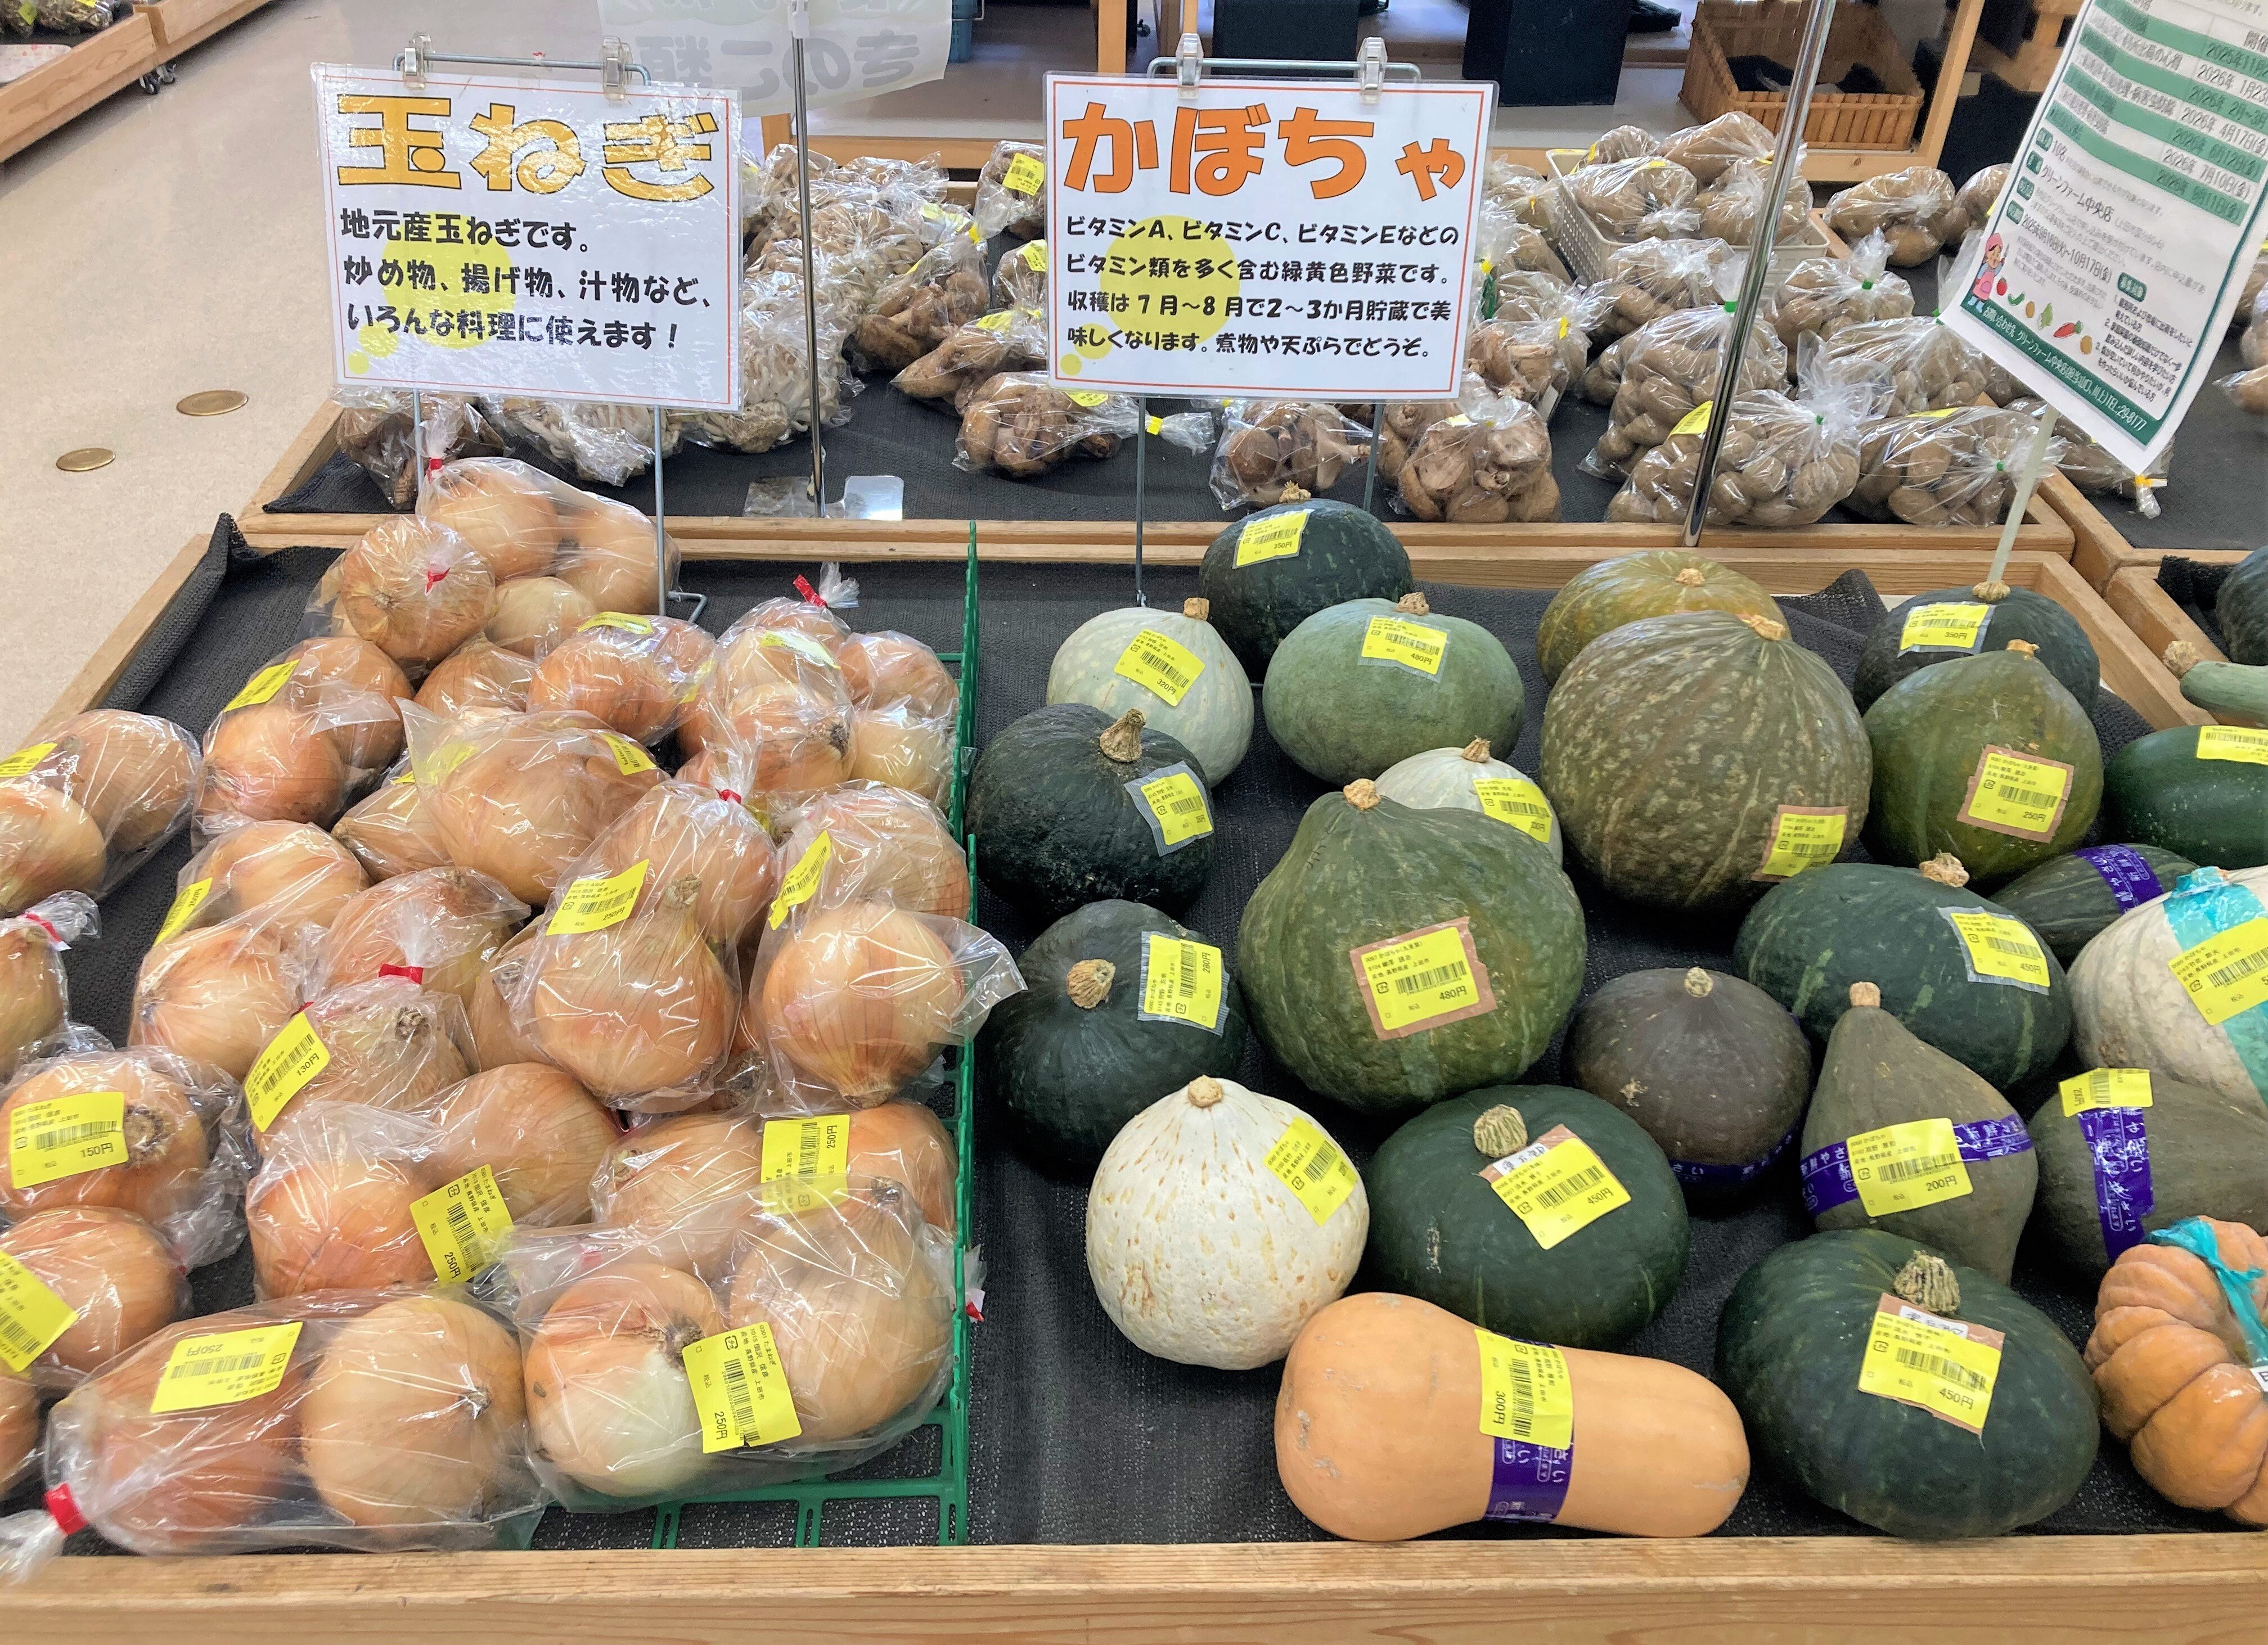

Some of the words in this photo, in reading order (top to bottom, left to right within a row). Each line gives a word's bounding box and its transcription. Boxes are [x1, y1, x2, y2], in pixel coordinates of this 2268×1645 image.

[2197, 61, 2237, 91] 2026年
[2180, 104, 2217, 133] 2026年
[337, 93, 720, 202] 玉ねぎ
[1063, 102, 1465, 202] かぼちゃ
[2161, 147, 2198, 175] 2026年
[340, 208, 589, 253] 地元産玉ねぎです。
[1067, 216, 1460, 246] ビタミンA、ビタミンC、ビタミンEなどの
[343, 255, 711, 308] 炒め物、揚げ物、汁物など、
[1067, 254, 1449, 285] ビタミン類を多く含む緑黄色野菜です。
[347, 303, 678, 350] いろんな料理に使えます！
[1068, 327, 1430, 358] 味しくなります。煮物や天ぷらでどうぞ。
[1410, 653, 1432, 665] 480円
[1154, 678, 1177, 696] 320円
[2023, 810, 2046, 822] 250円
[600, 906, 627, 921] 250円
[1199, 952, 1212, 972] 280円
[1438, 985, 1468, 1003] 480円
[295, 1051, 321, 1079] 130円
[79, 1142, 114, 1158] 150円
[826, 1125, 837, 1148] 250円
[482, 1178, 496, 1201] たまねぎ
[1586, 1186, 1614, 1207] 450円
[1925, 1175, 1957, 1191] 200円
[466, 1189, 479, 1213] 長野県産
[477, 1215, 489, 1233] 上田市
[443, 1251, 462, 1279] 250円
[740, 1330, 749, 1345] 産地
[749, 1327, 758, 1342] 7015
[184, 1342, 224, 1356] 250円
[744, 1347, 757, 1375] 長野県産
[763, 1340, 776, 1367] たまねぎ
[754, 1379, 764, 1401] 上田市
[1937, 1386, 1975, 1409] 450円
[703, 1373, 712, 1389] 税込
[711, 1410, 729, 1440] 250円
[1489, 1390, 1509, 1426] 300円
